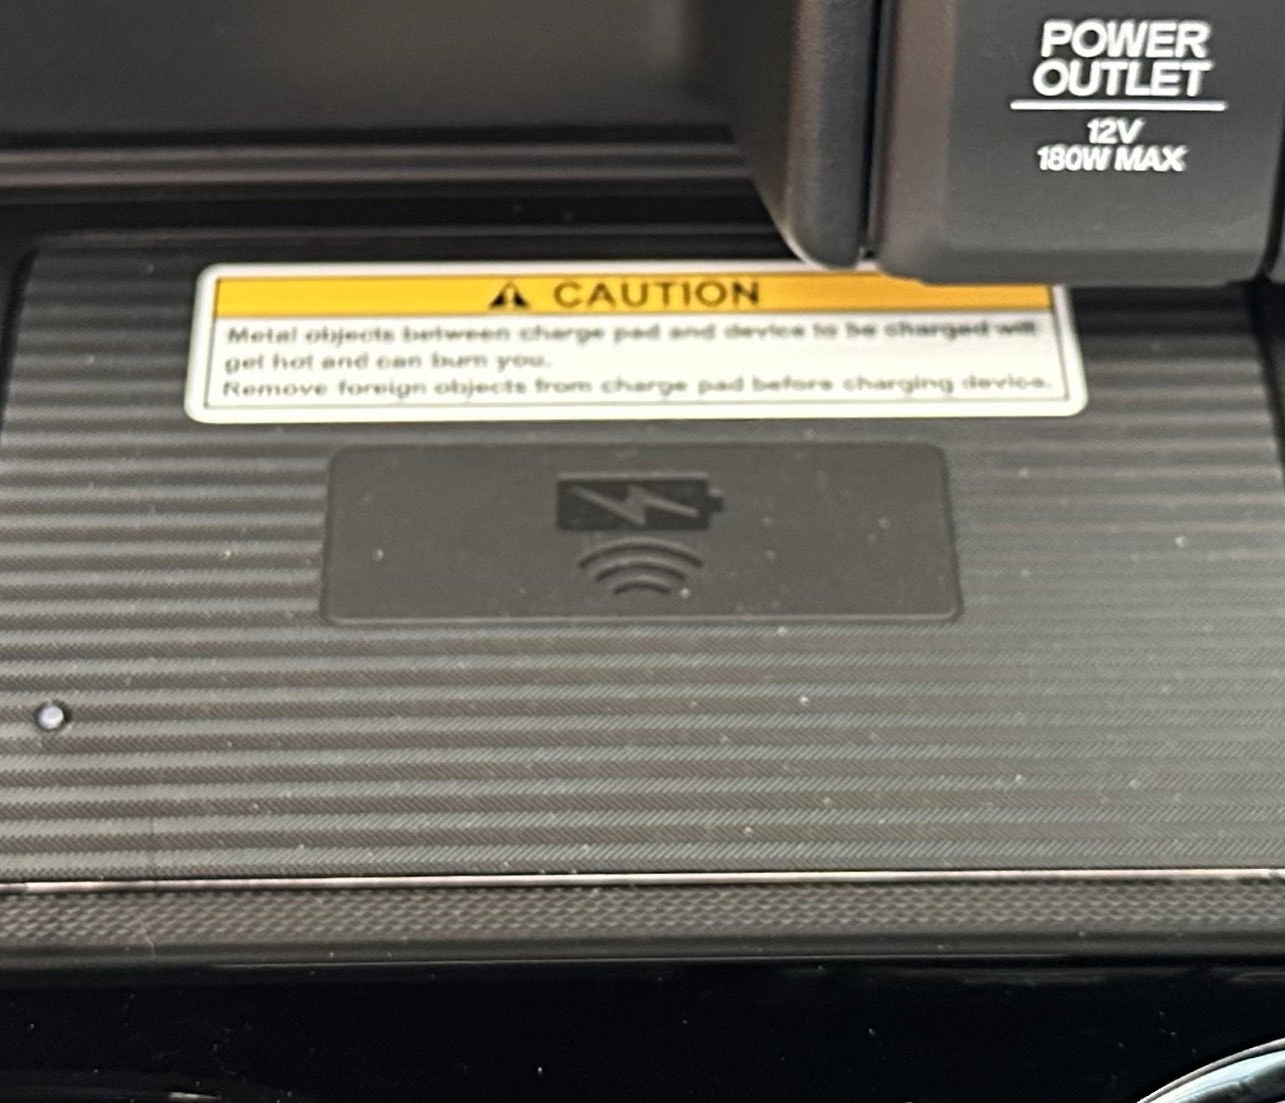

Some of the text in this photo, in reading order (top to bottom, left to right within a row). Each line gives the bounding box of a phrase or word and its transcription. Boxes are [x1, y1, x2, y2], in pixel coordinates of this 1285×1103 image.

[1040, 19, 1211, 59] POWER
[1031, 59, 1215, 97] OUTLET
[1086, 117, 1146, 145] 12V
[1036, 145, 1188, 172] 180W MAX
[553, 280, 760, 308] CAUTION
[226, 319, 1037, 347] Metal objects between charge pad and device to be charged will
[224, 352, 553, 374] get hot and can burn you.
[222, 373, 1053, 400] Remove foreign objects from charge pad before charging device.
